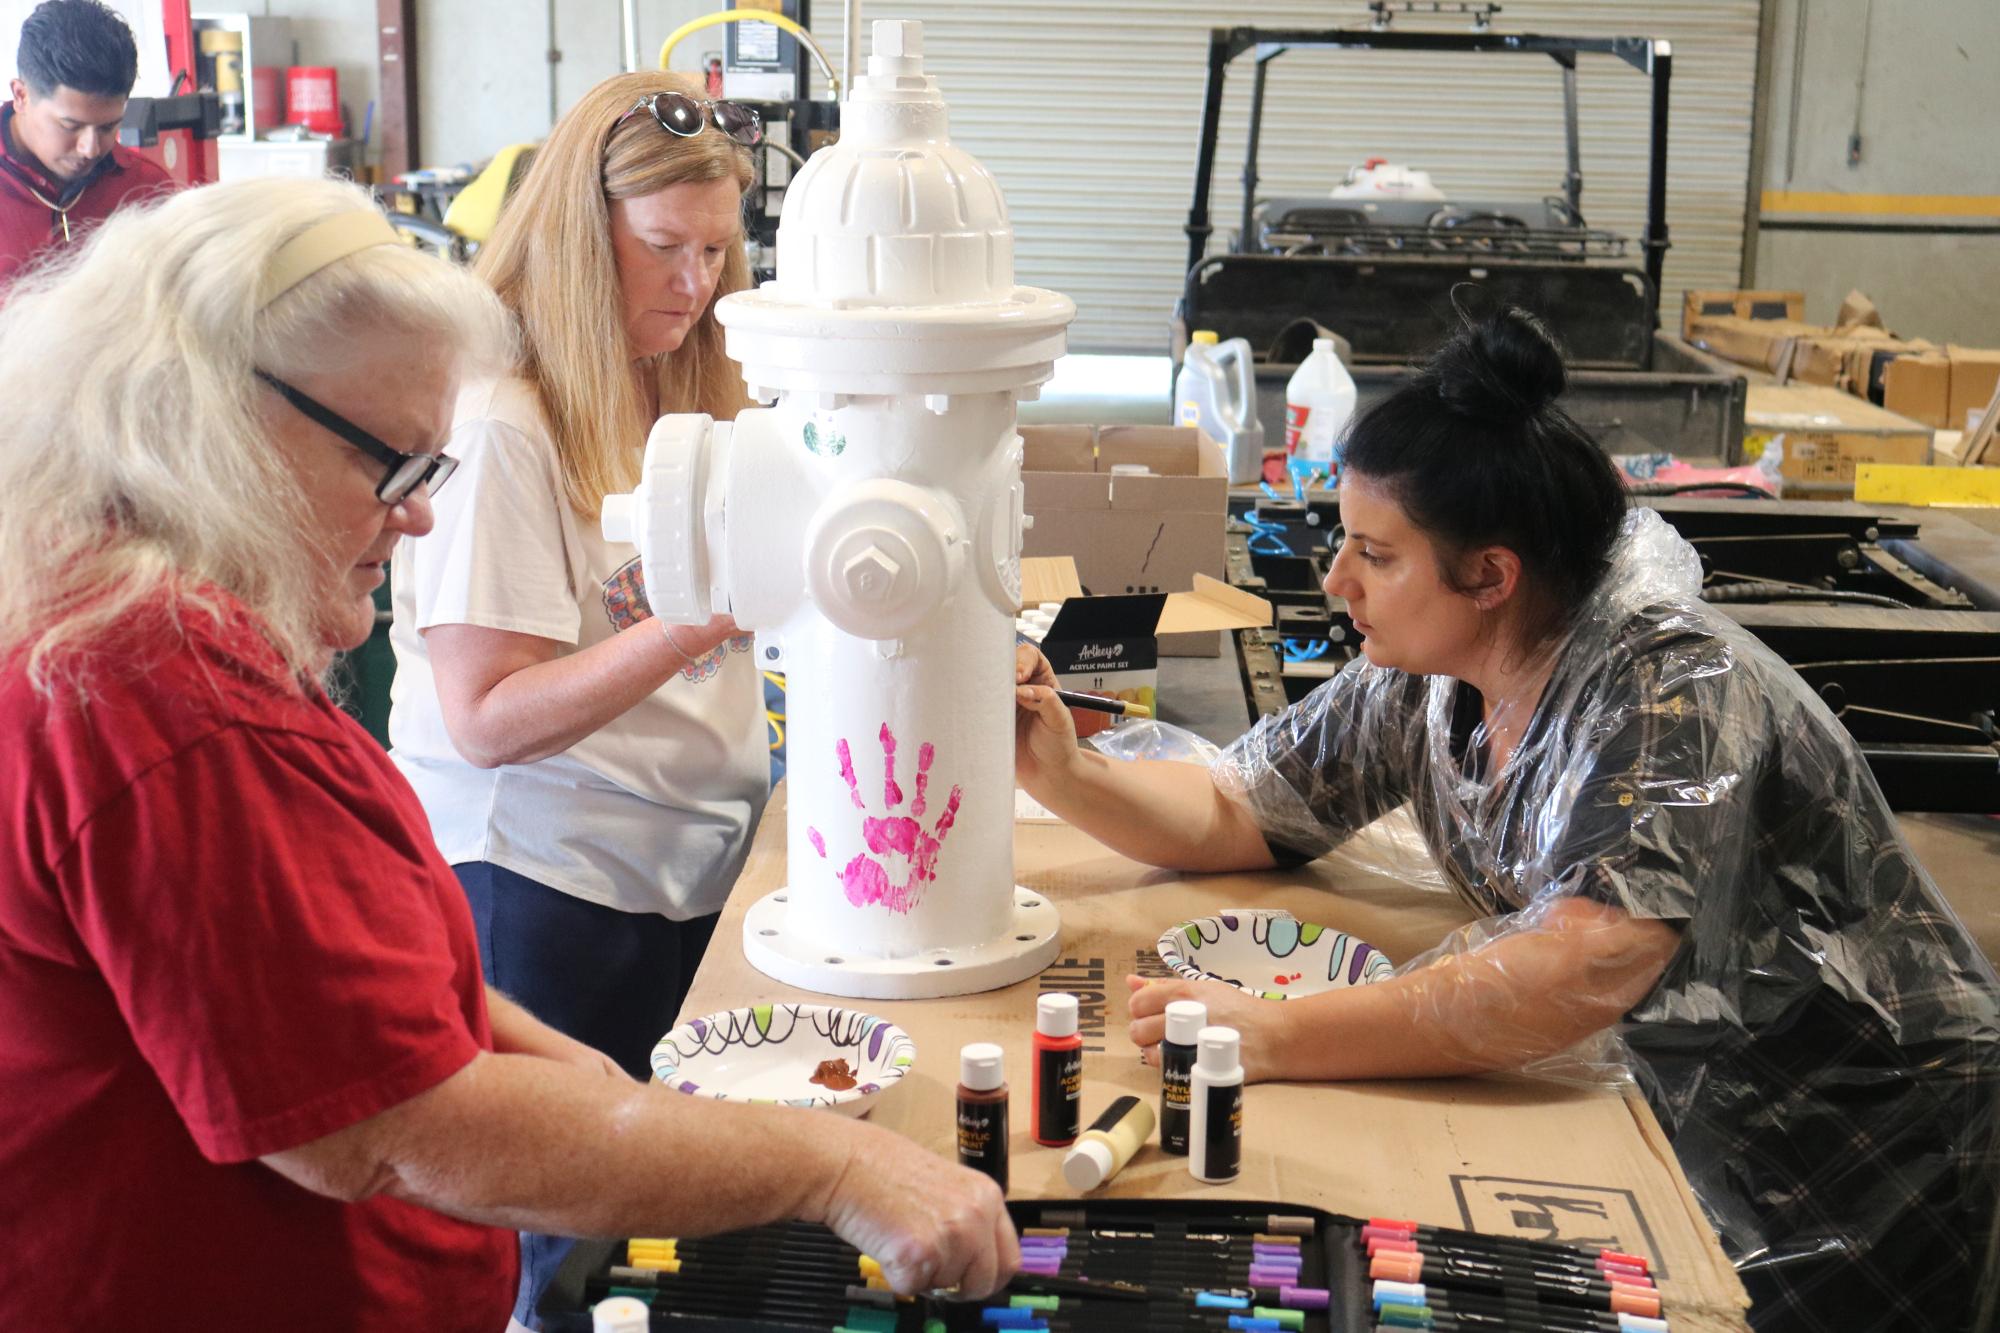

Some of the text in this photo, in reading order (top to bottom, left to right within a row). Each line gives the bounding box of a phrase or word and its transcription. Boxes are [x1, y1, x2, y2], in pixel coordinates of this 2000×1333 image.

[1078, 643, 1112, 660] Artkey
[1069, 661, 1129, 671] ACRYLIC PAINT SET
